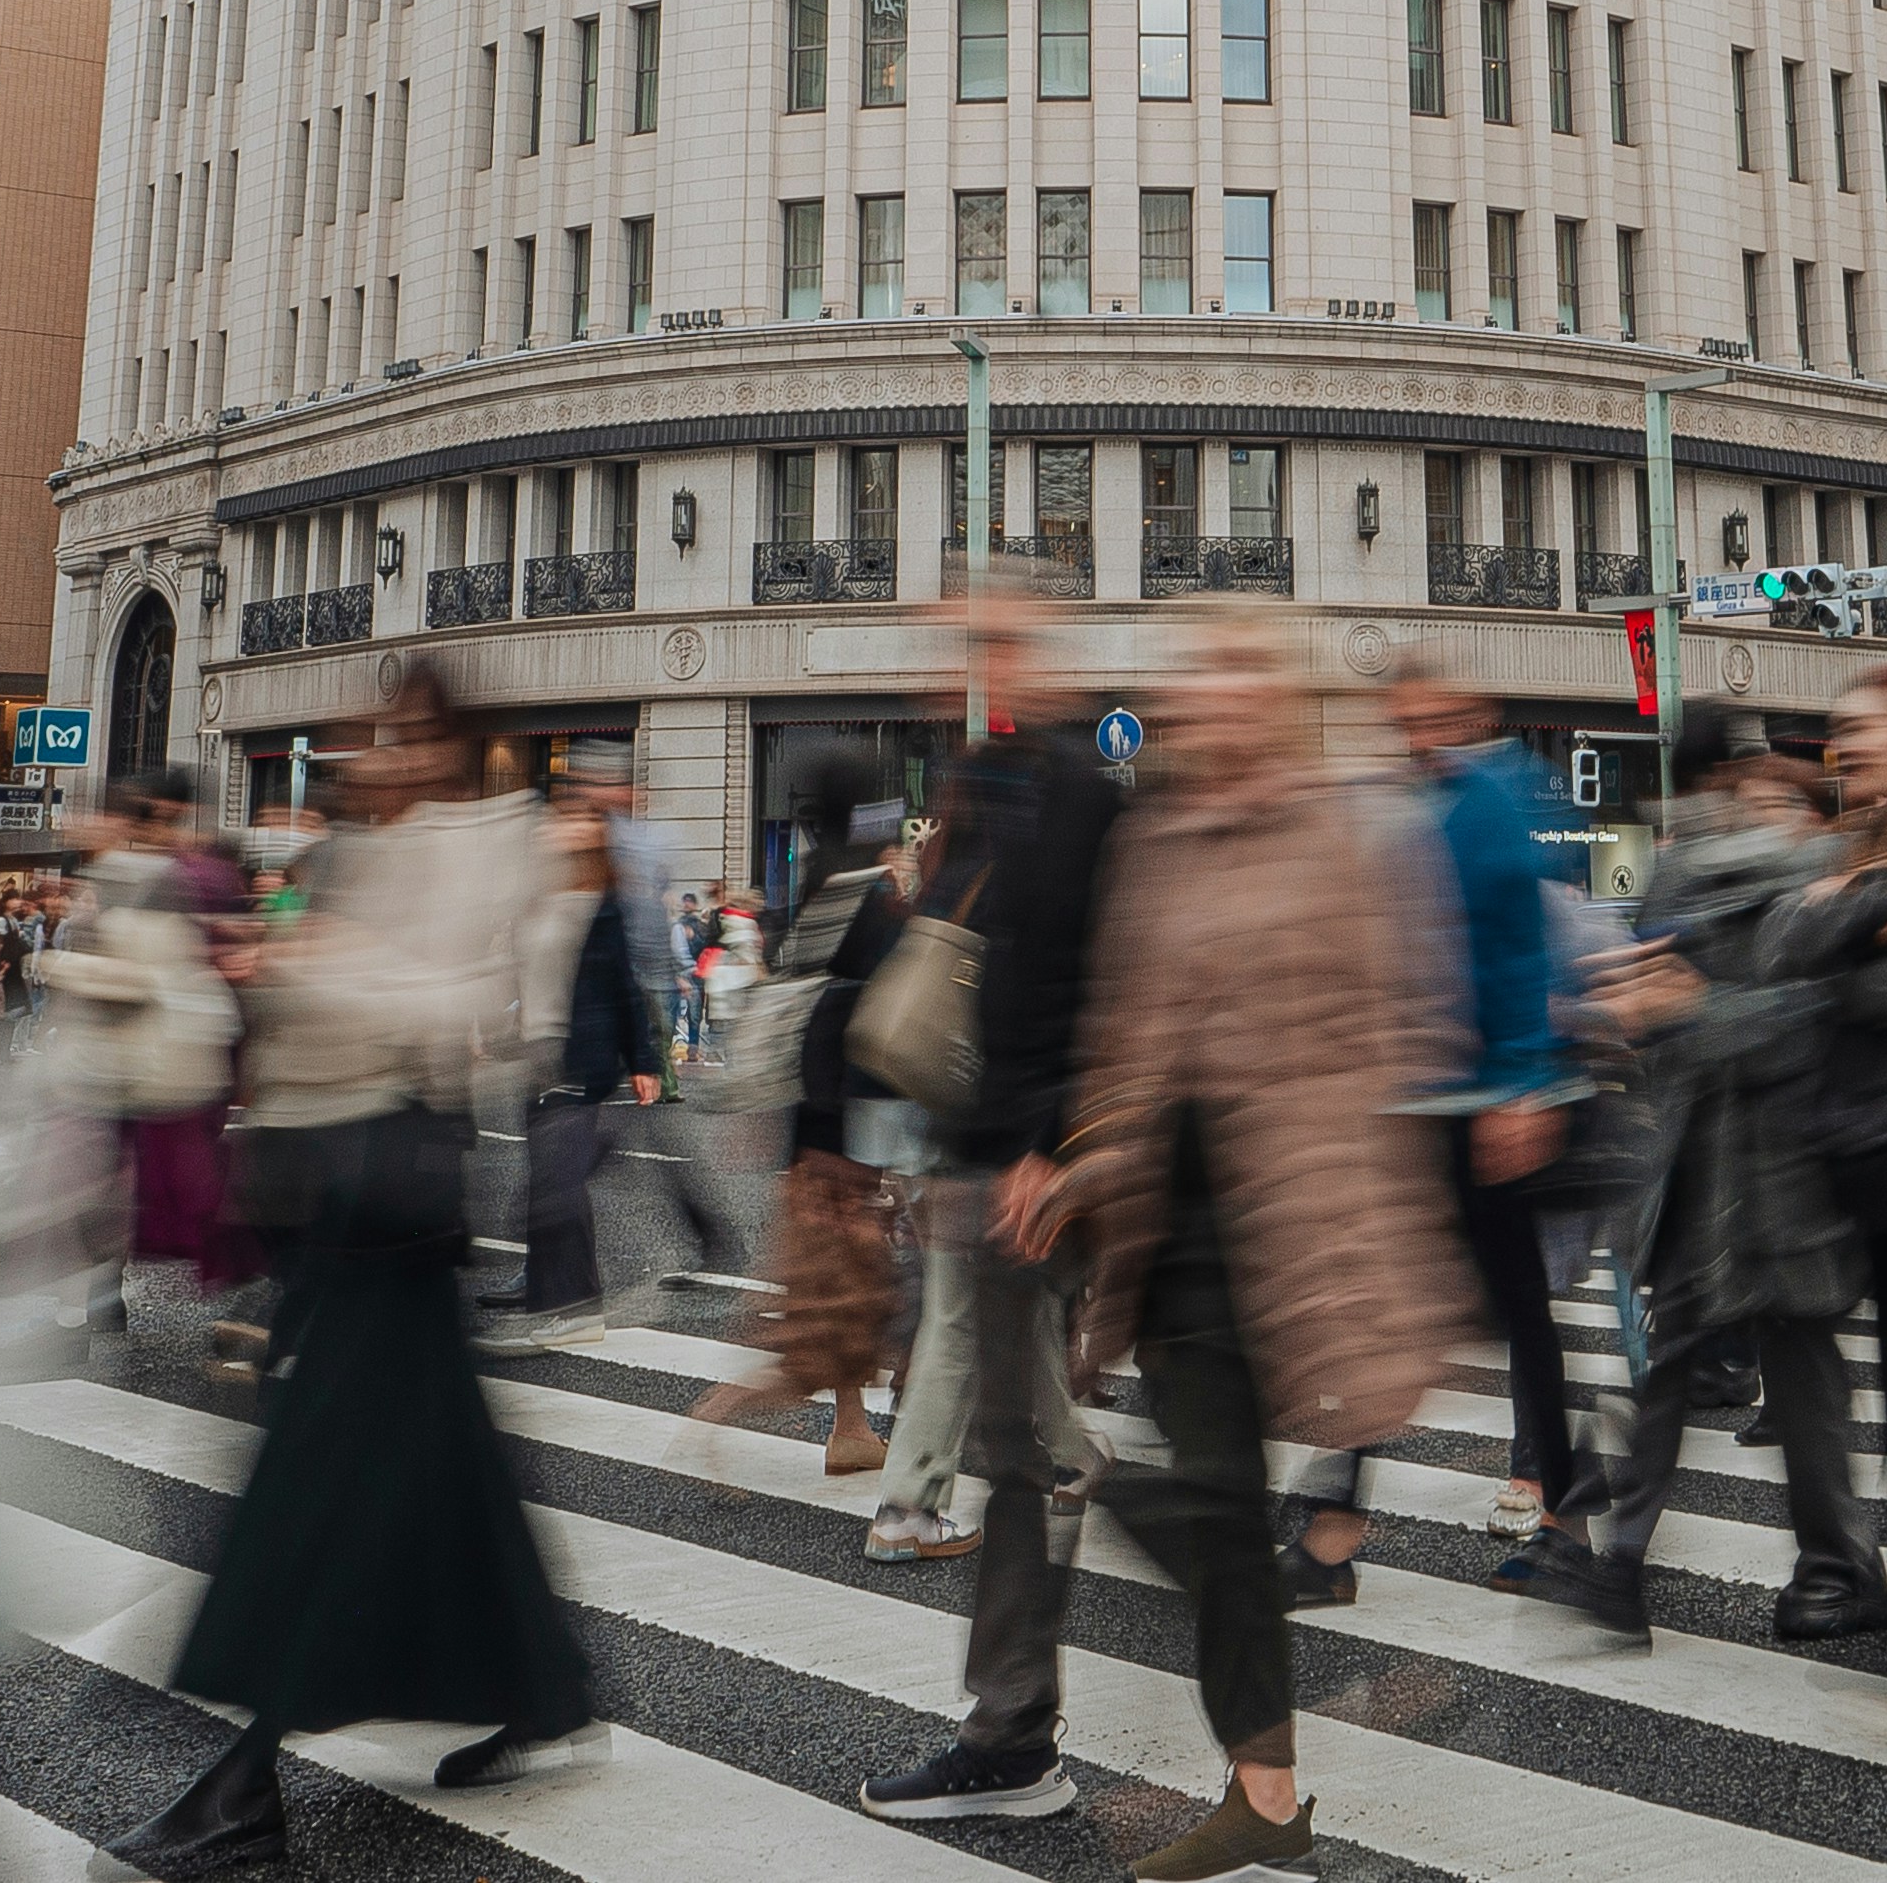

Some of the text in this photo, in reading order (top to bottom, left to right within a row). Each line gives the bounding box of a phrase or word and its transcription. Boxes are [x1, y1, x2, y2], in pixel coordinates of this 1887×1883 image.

[1716, 599, 1745, 611] Ginza 4
[1549, 775, 1564, 791] GS
[1529, 830, 1563, 845] Flagship
